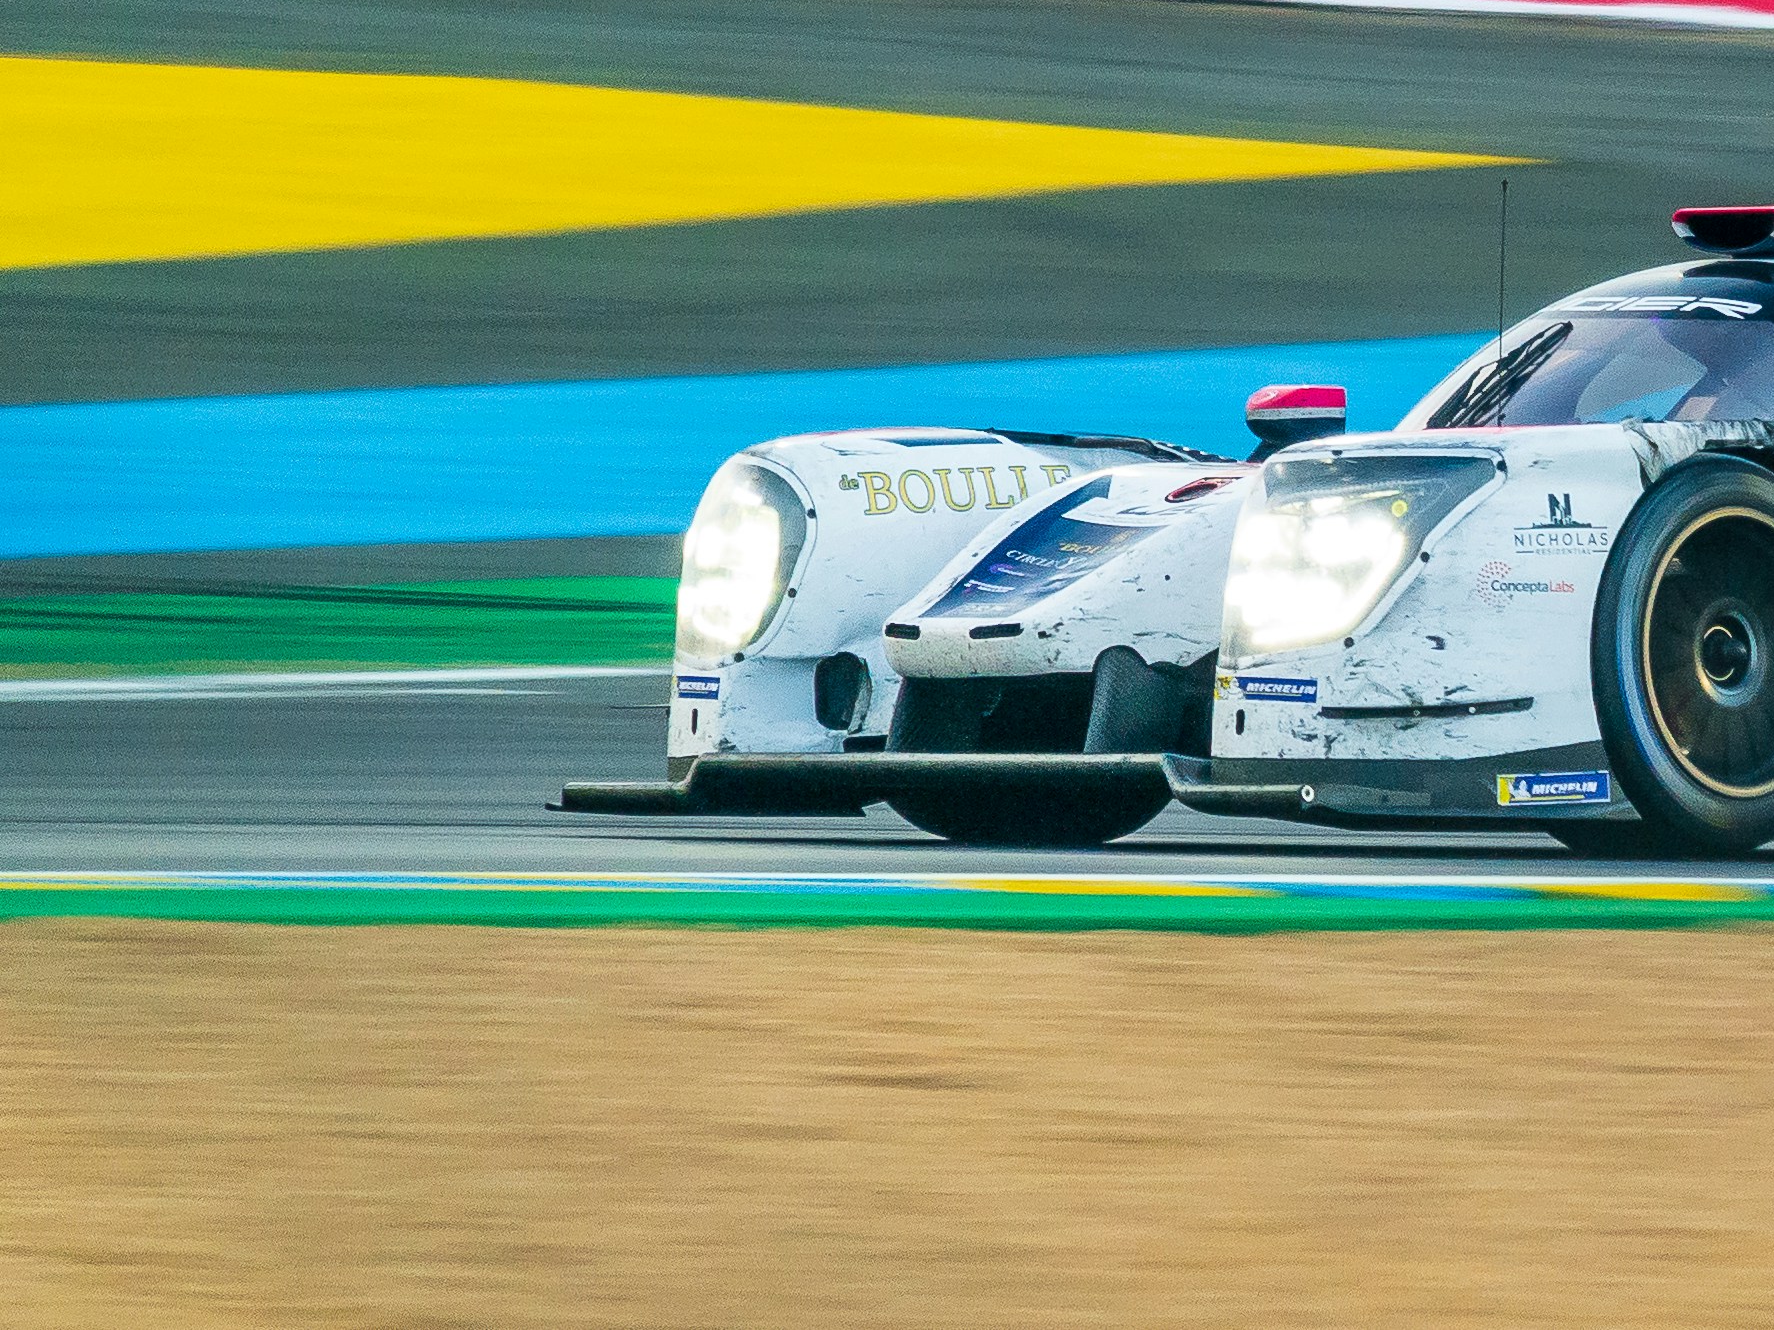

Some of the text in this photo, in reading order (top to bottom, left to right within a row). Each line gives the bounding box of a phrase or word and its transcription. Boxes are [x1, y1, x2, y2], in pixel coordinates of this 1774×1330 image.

[839, 474, 860, 491] de
[1514, 533, 1609, 547] NICHOLAS
[1246, 682, 1317, 695] MICHELIN
[1531, 781, 1598, 795] MICHELIN
